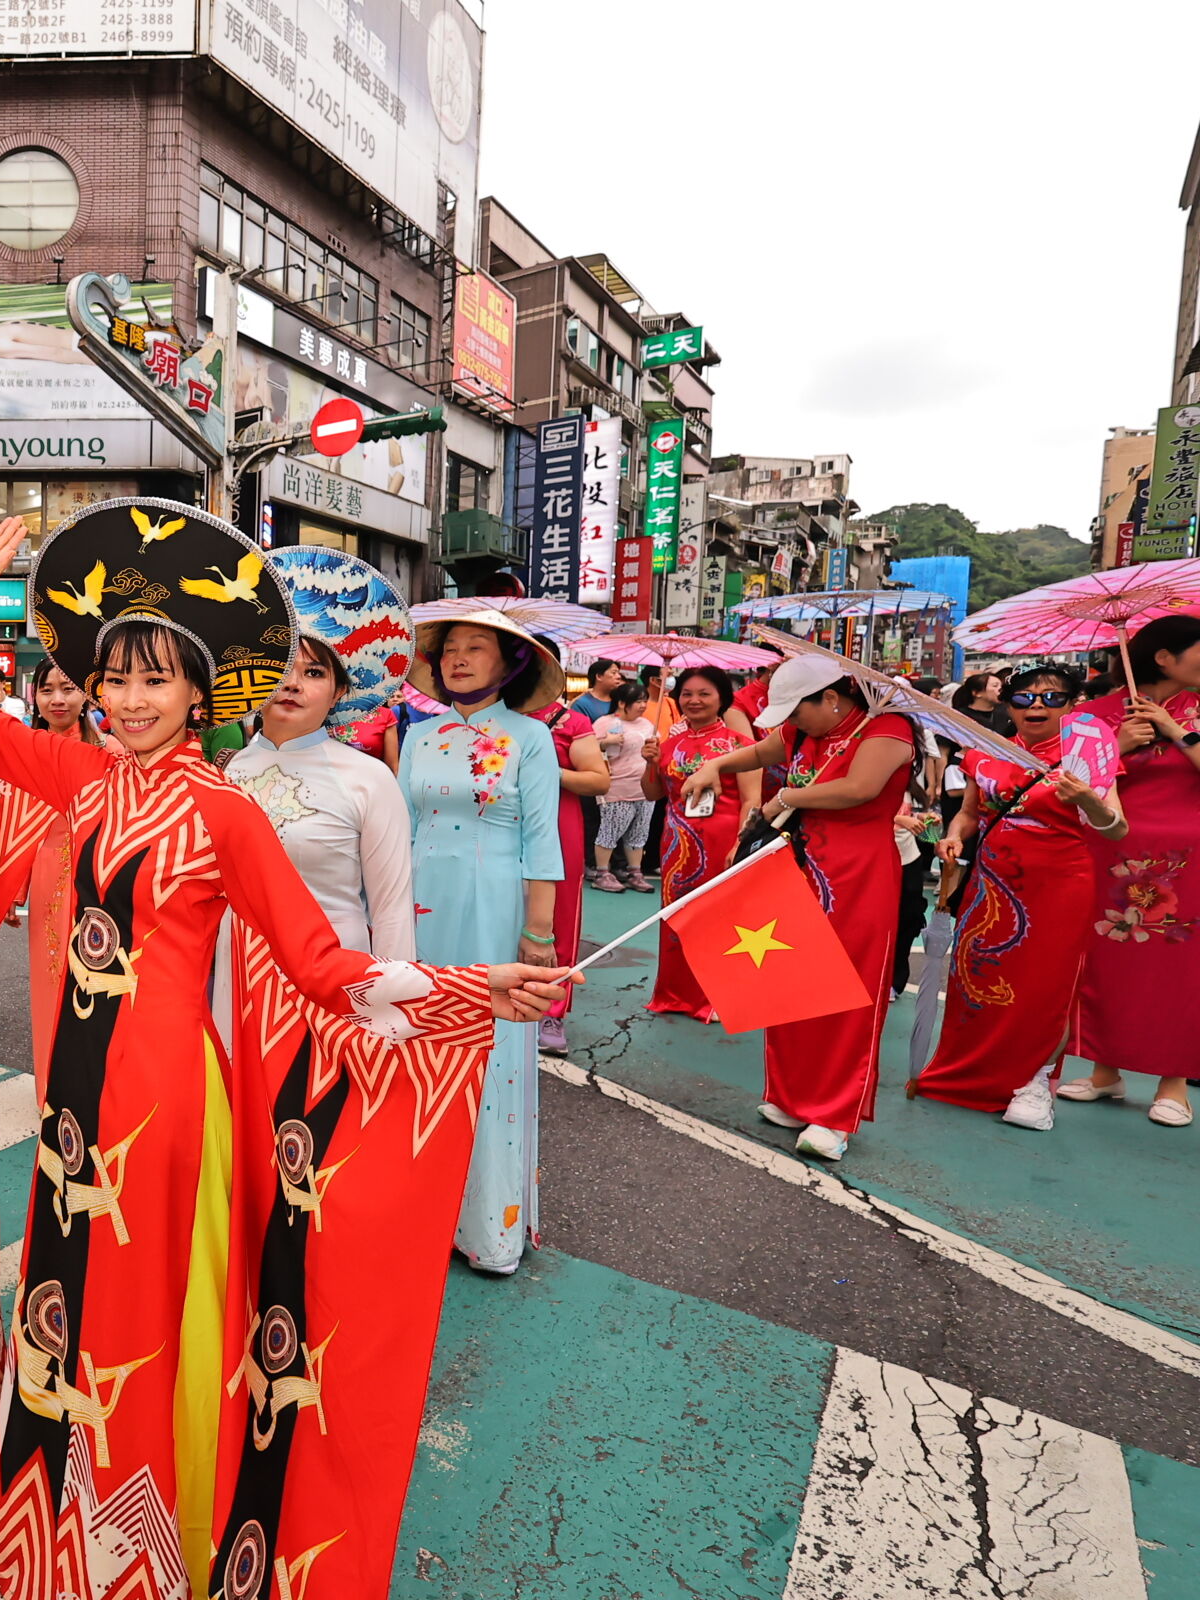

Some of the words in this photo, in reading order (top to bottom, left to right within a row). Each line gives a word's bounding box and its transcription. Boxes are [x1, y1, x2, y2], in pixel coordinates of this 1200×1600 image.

[112, 317, 145, 352] 基隆
[299, 327, 367, 388] 美夢成真
[545, 425, 575, 445] SF
[283, 463, 362, 519] 尚洋髮藝
[647, 460, 678, 550] 天仁茗茶
[1155, 500, 1197, 511] HOTE
[1138, 539, 1170, 547] YUNG
[1155, 547, 1185, 555] HOTE
